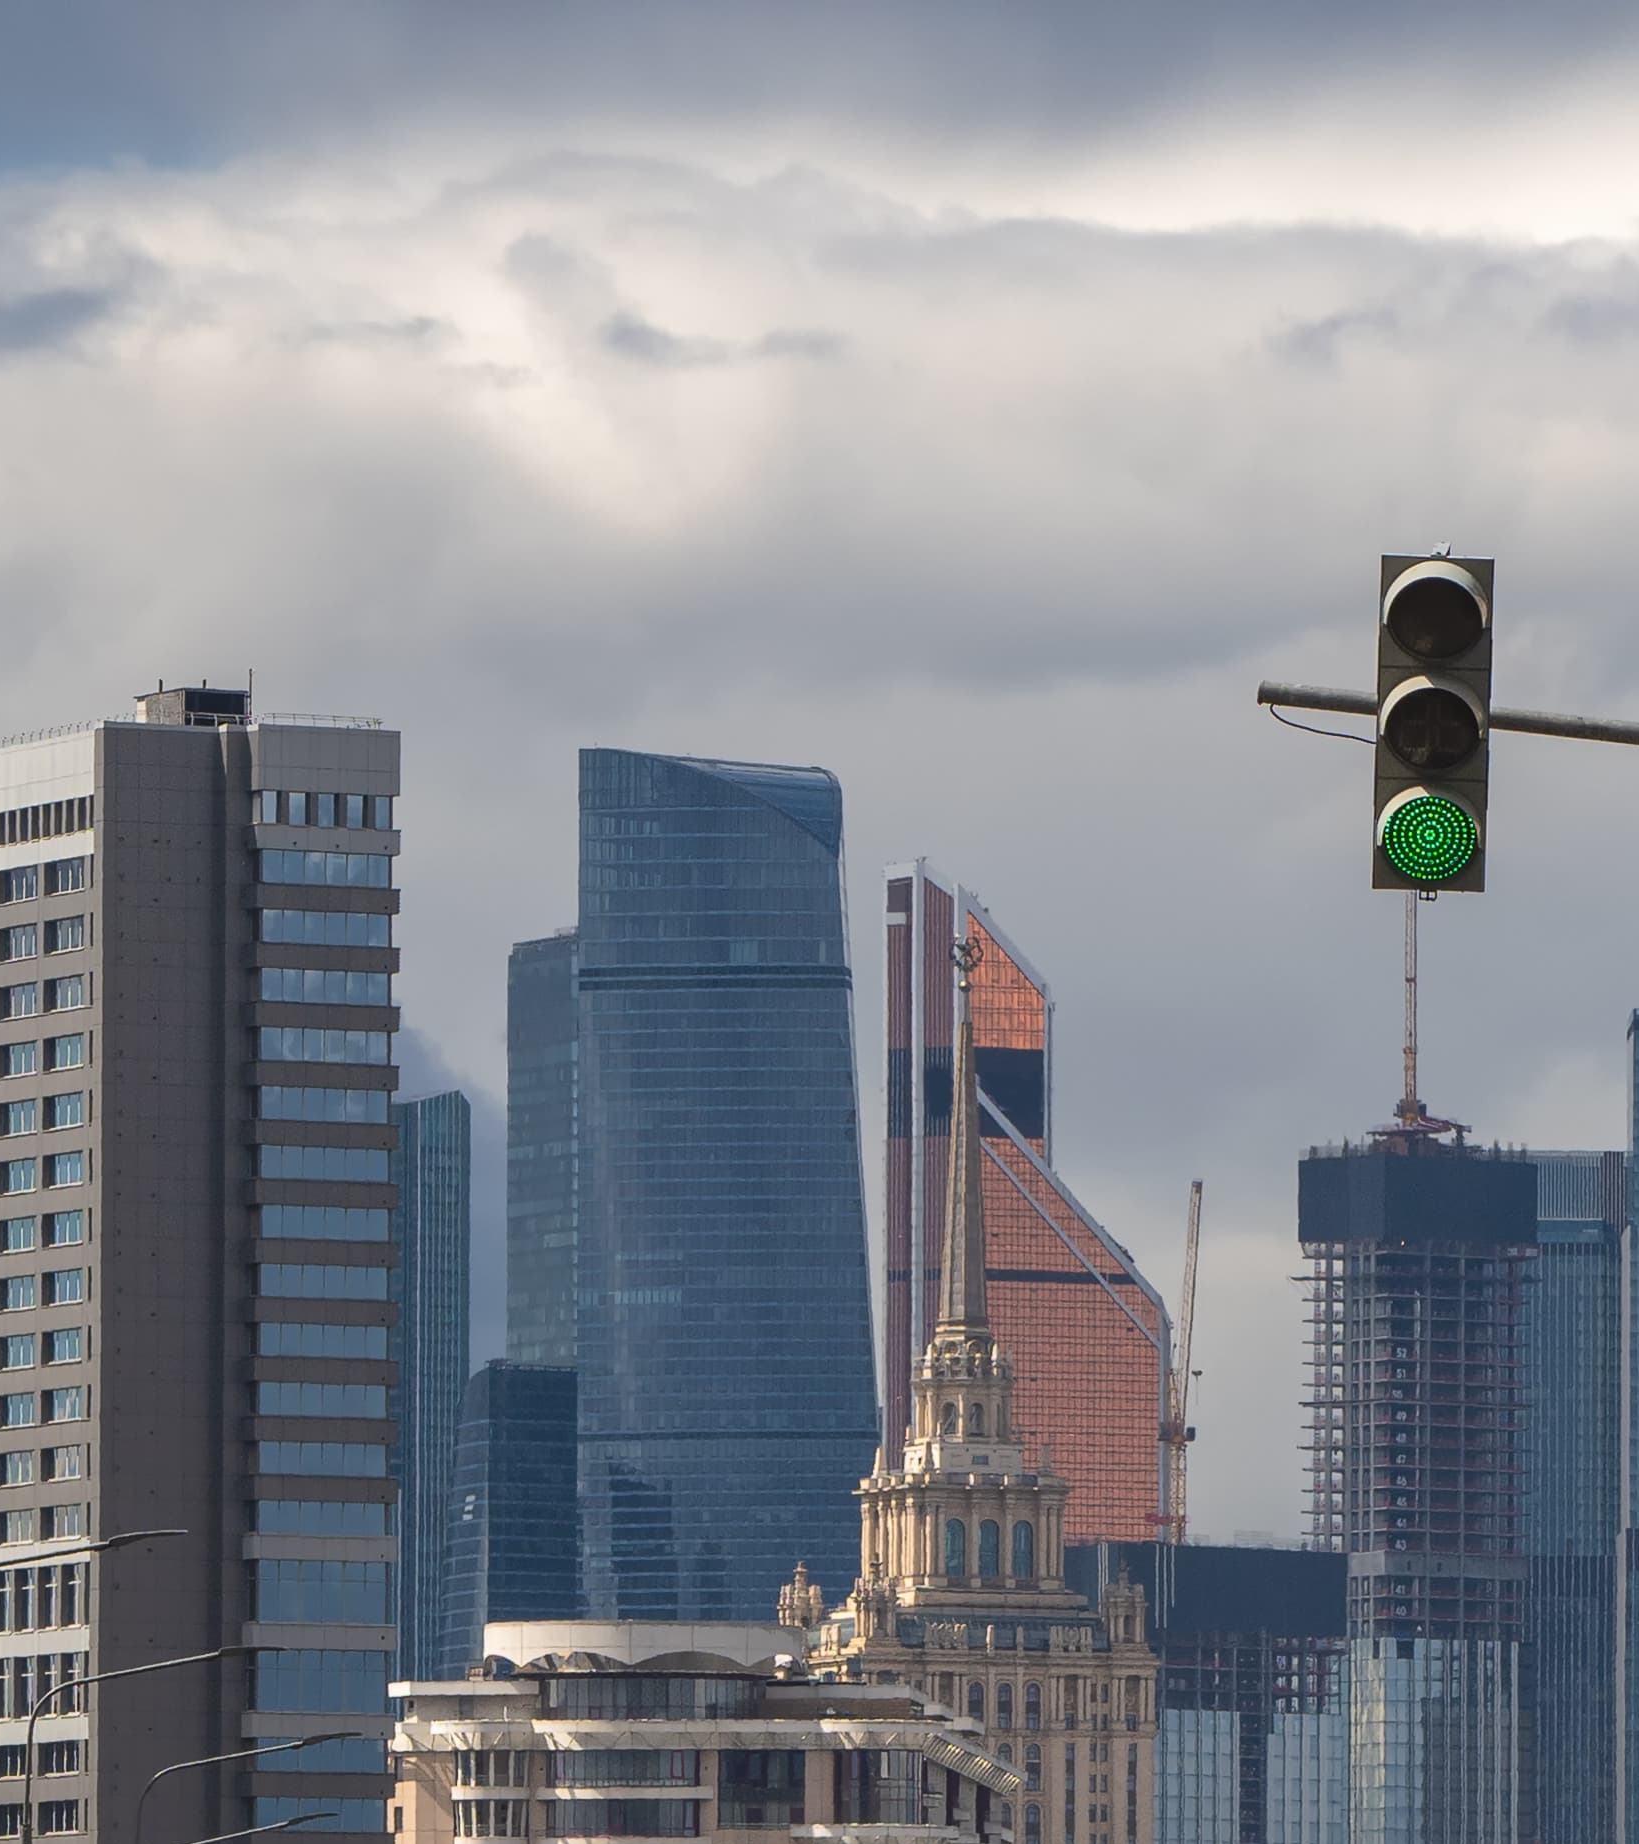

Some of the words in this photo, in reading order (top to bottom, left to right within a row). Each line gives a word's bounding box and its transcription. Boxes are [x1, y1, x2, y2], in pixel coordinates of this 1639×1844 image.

[1396, 1347, 1407, 1358] 52
[1396, 1368, 1406, 1378] 51
[1395, 1584, 1406, 1594] 41
[1395, 1605, 1407, 1616] 40
